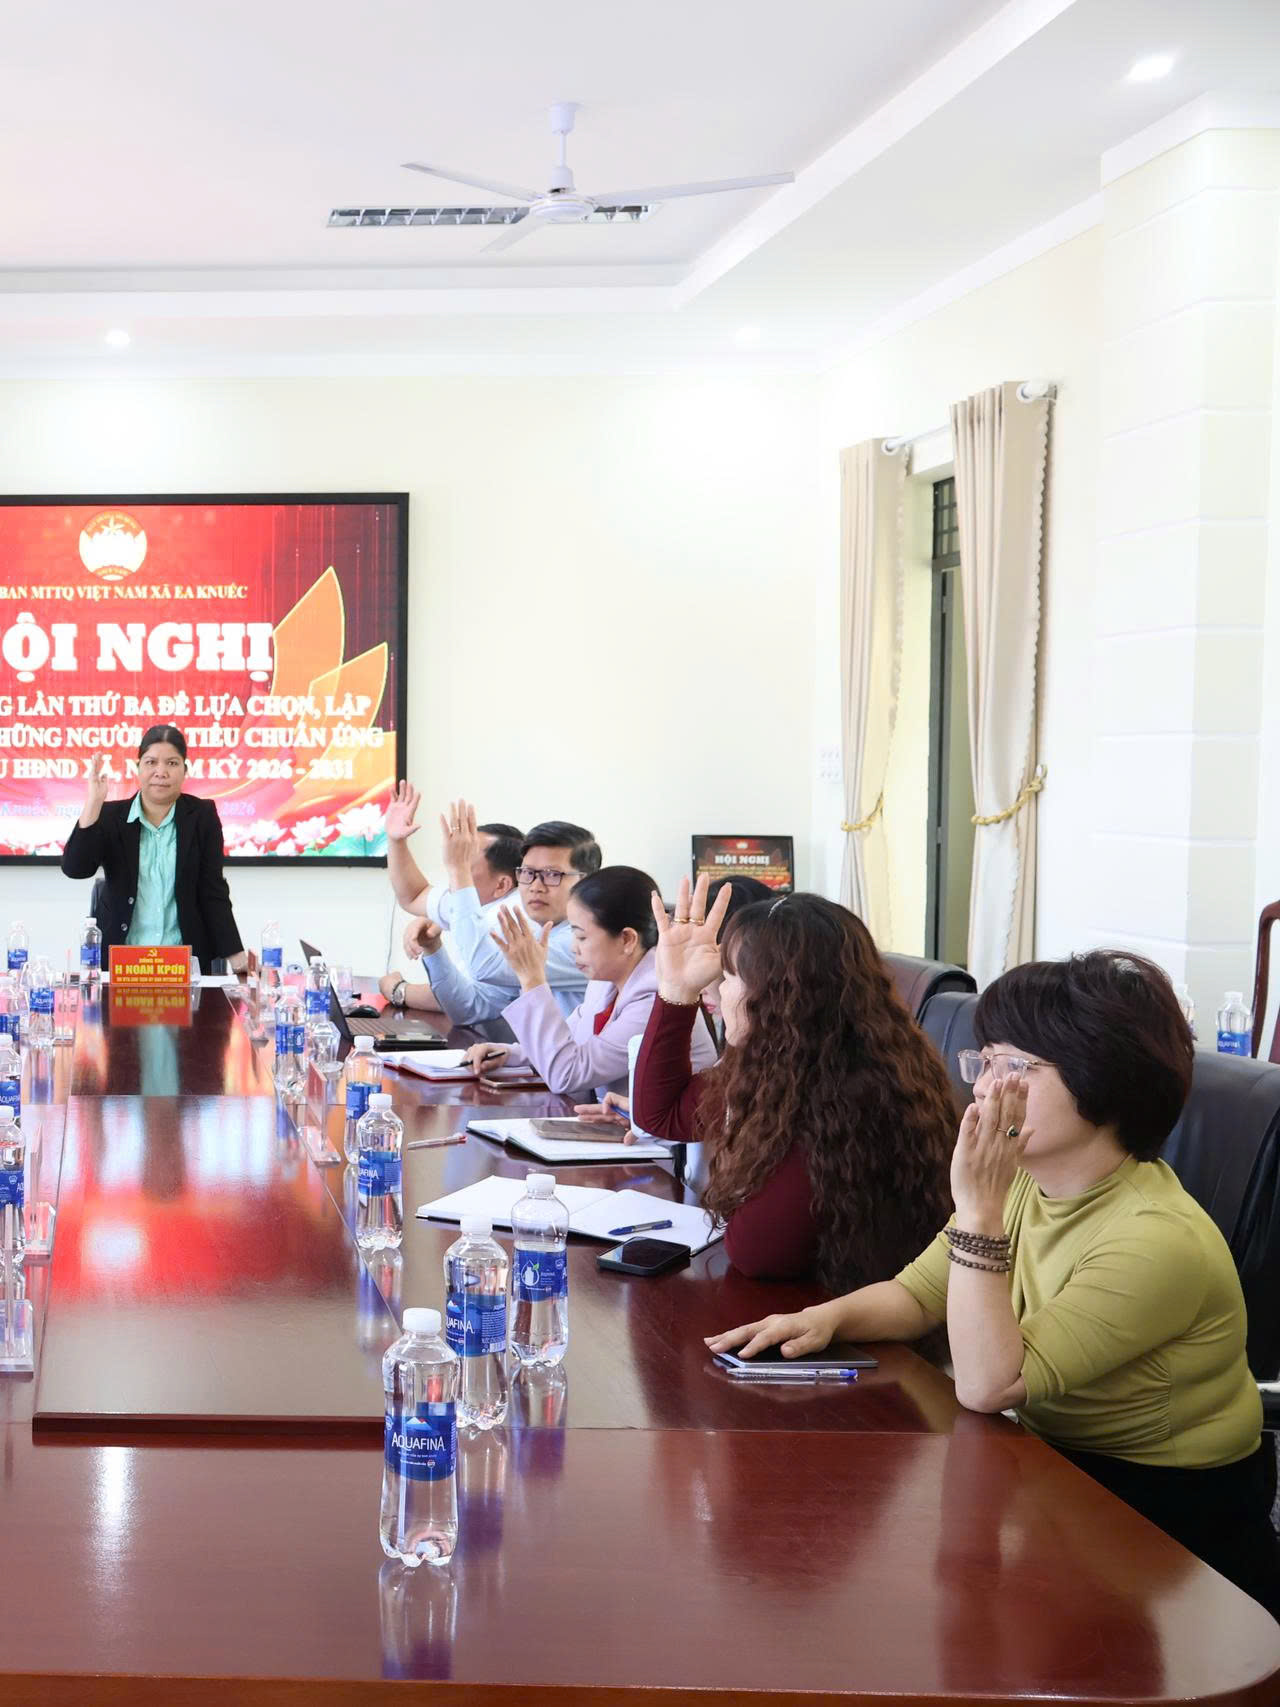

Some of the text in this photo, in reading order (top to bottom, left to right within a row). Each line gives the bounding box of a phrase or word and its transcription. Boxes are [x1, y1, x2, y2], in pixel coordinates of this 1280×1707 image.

[30, 586, 75, 601] MTTQ
[77, 585, 111, 602] VIỆT
[113, 586, 147, 599] NAM
[151, 584, 172, 599] XÃ
[174, 586, 194, 599] EA
[96, 622, 274, 682] NGHỊ
[68, 690, 121, 717] THỨ
[123, 696, 155, 717] BA
[194, 693, 245, 721] LỰA
[247, 695, 321, 721] CHỌN,
[324, 691, 372, 721] LẬP
[66, 722, 141, 748] NGƯỜI
[184, 723, 239, 748] TIÊU
[331, 720, 384, 748] ỨNG
[12, 758, 78, 779] HĐND
[207, 753, 242, 779] KỲ
[246, 758, 293, 779] 2026
[310, 758, 354, 779] 2031
[715, 855, 770, 865] HỘI NGHỊ
[392, 1431, 447, 1452] AQUAFINA
